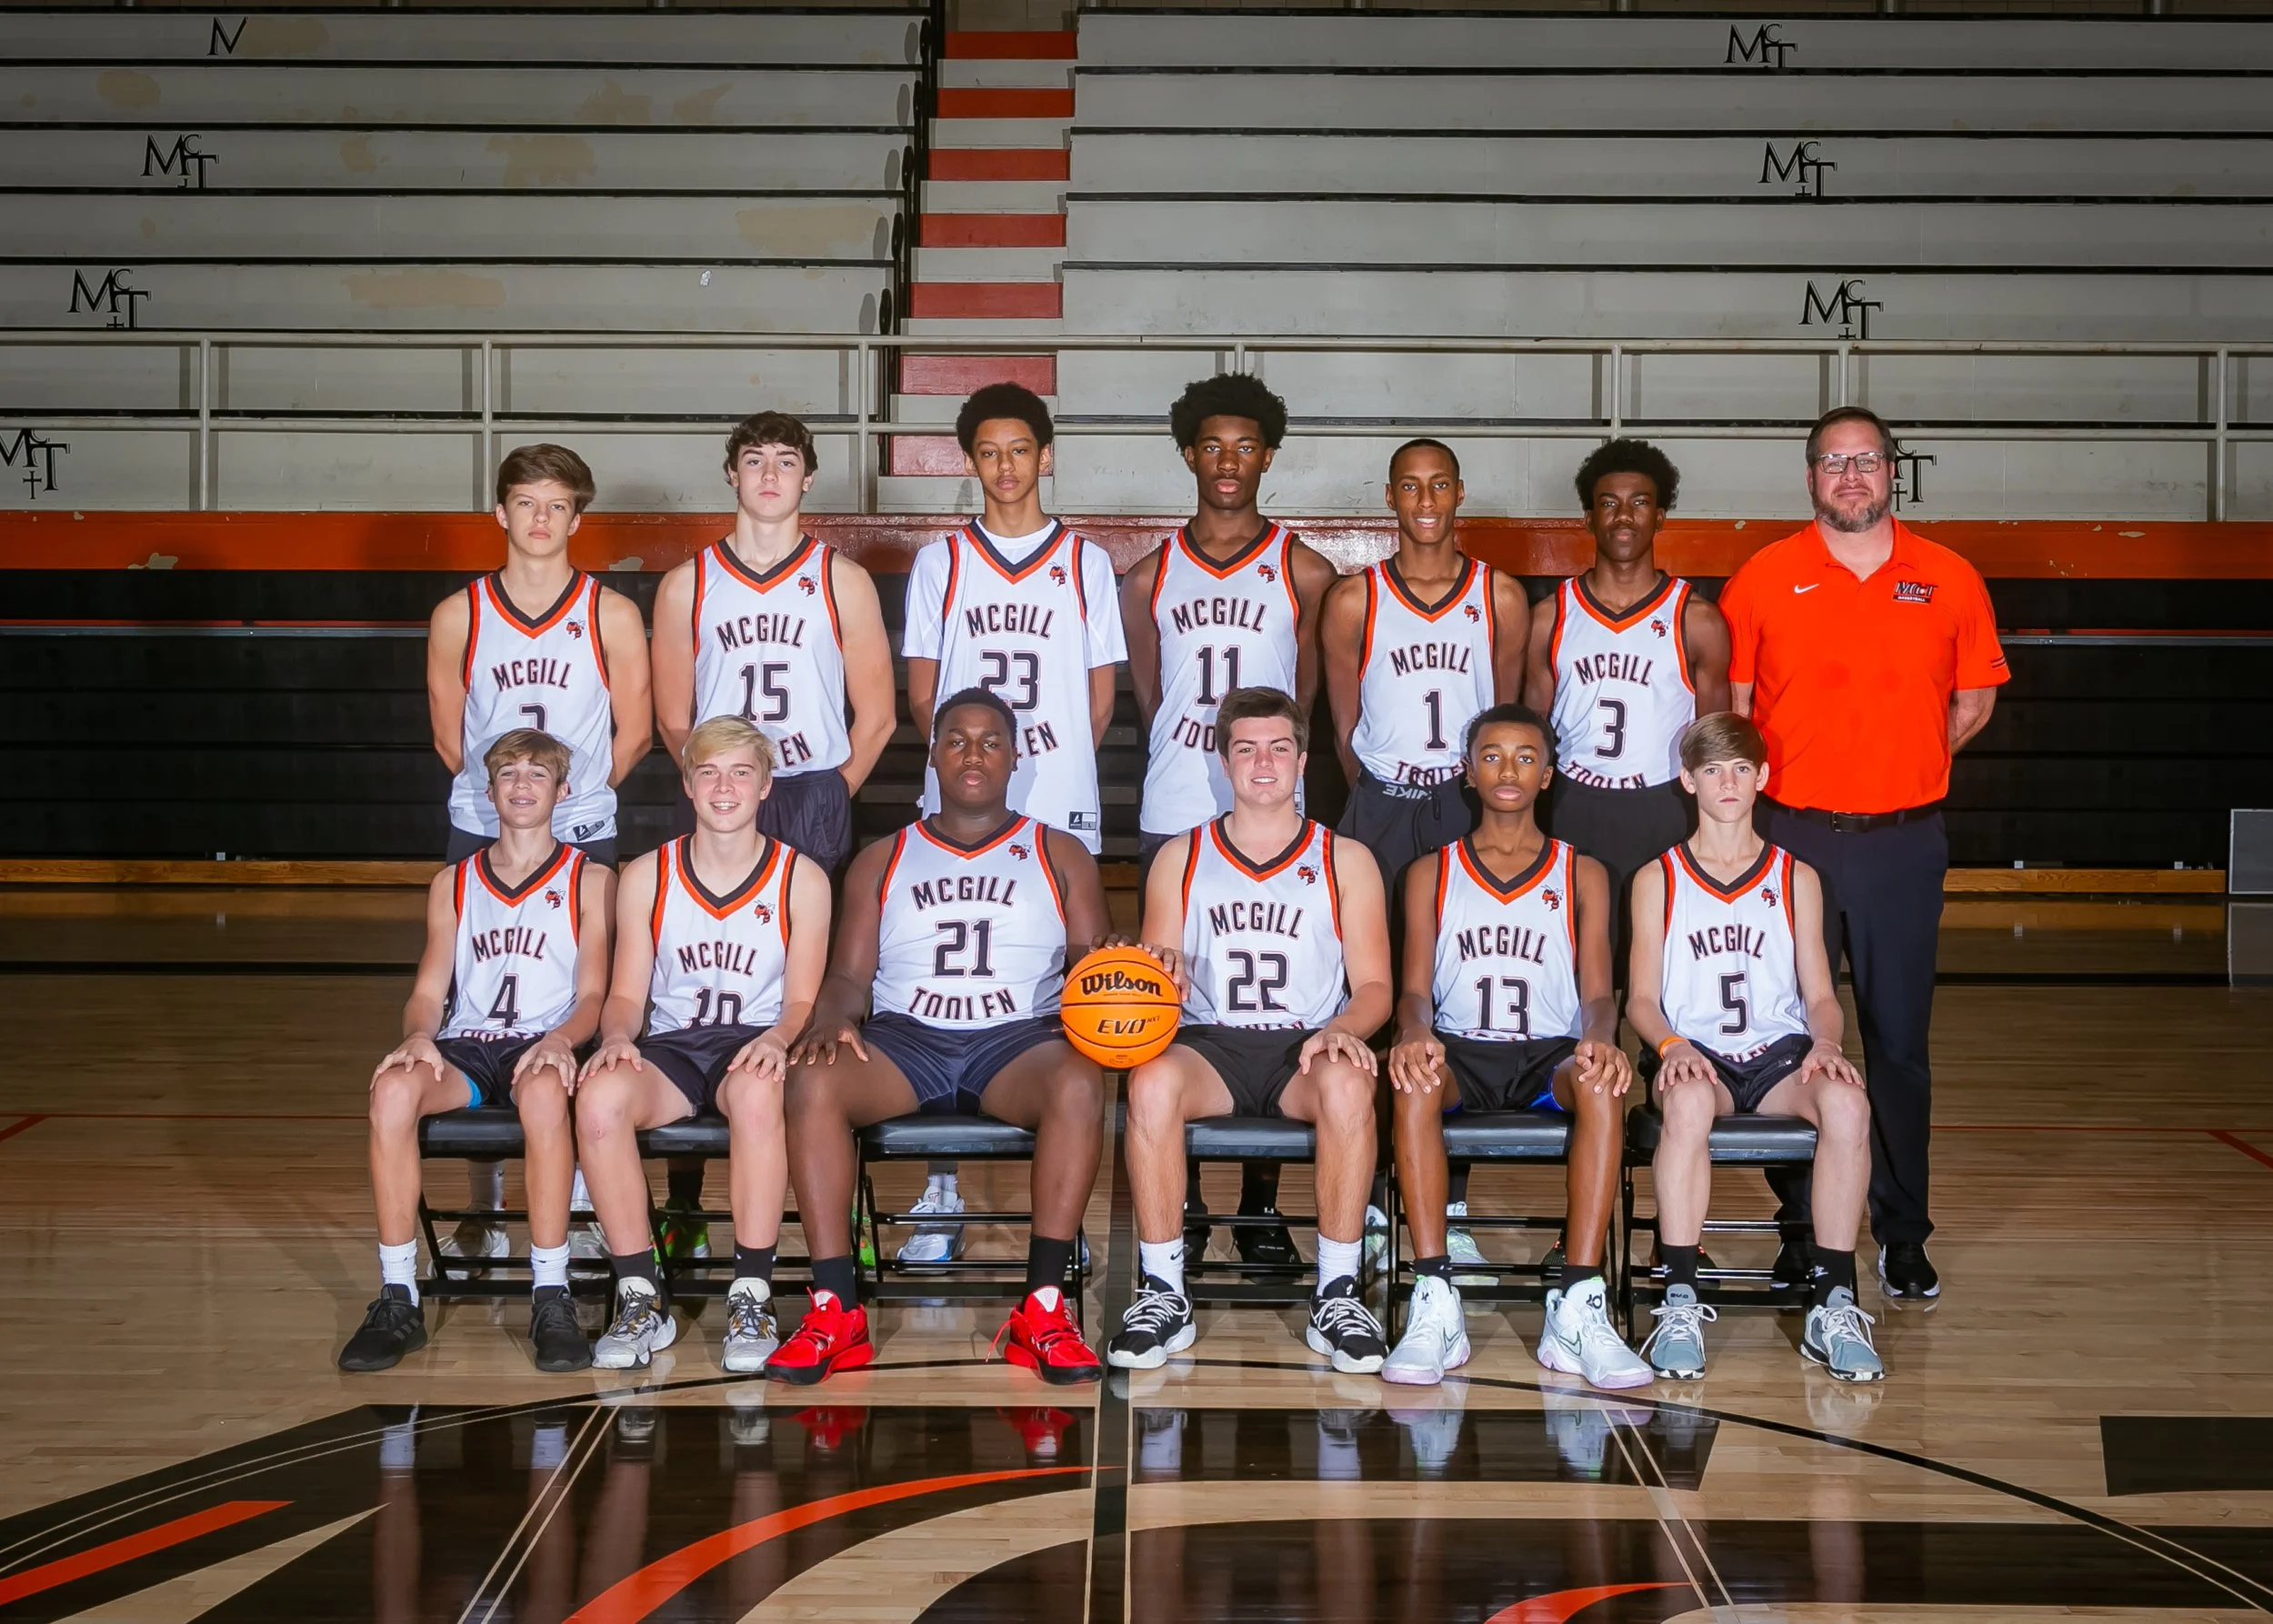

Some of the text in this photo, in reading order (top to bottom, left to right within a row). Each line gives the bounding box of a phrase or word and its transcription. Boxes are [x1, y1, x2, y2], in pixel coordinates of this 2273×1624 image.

[715, 613, 806, 653] MCGILL
[965, 603, 1056, 640] MCGILL
[1170, 596, 1268, 636] MCGILL
[490, 657, 572, 693] MCGILL
[1196, 645, 1241, 707] 11
[1388, 642, 1472, 678] MCGILL
[1573, 653, 1654, 688] MCGILL
[738, 661, 790, 724] 15
[978, 649, 1041, 712] 23
[1171, 713, 1217, 753] TOO
[1422, 688, 1449, 752] 1
[1594, 697, 1627, 761] 3
[909, 874, 1018, 913] MCGILL
[1208, 900, 1305, 940] MCGILL
[471, 925, 549, 967] MCGILL
[675, 939, 759, 977] MCGILL
[931, 917, 996, 979] 21
[1455, 924, 1547, 966] MCGILL
[1687, 923, 1767, 962] MCGILL
[486, 972, 522, 1029] 4
[1080, 971, 1164, 997] Wilson
[1225, 948, 1290, 1013] 22
[1473, 974, 1533, 1038] 13
[1717, 970, 1750, 1037] 5
[1096, 1019, 1147, 1035] EVO
